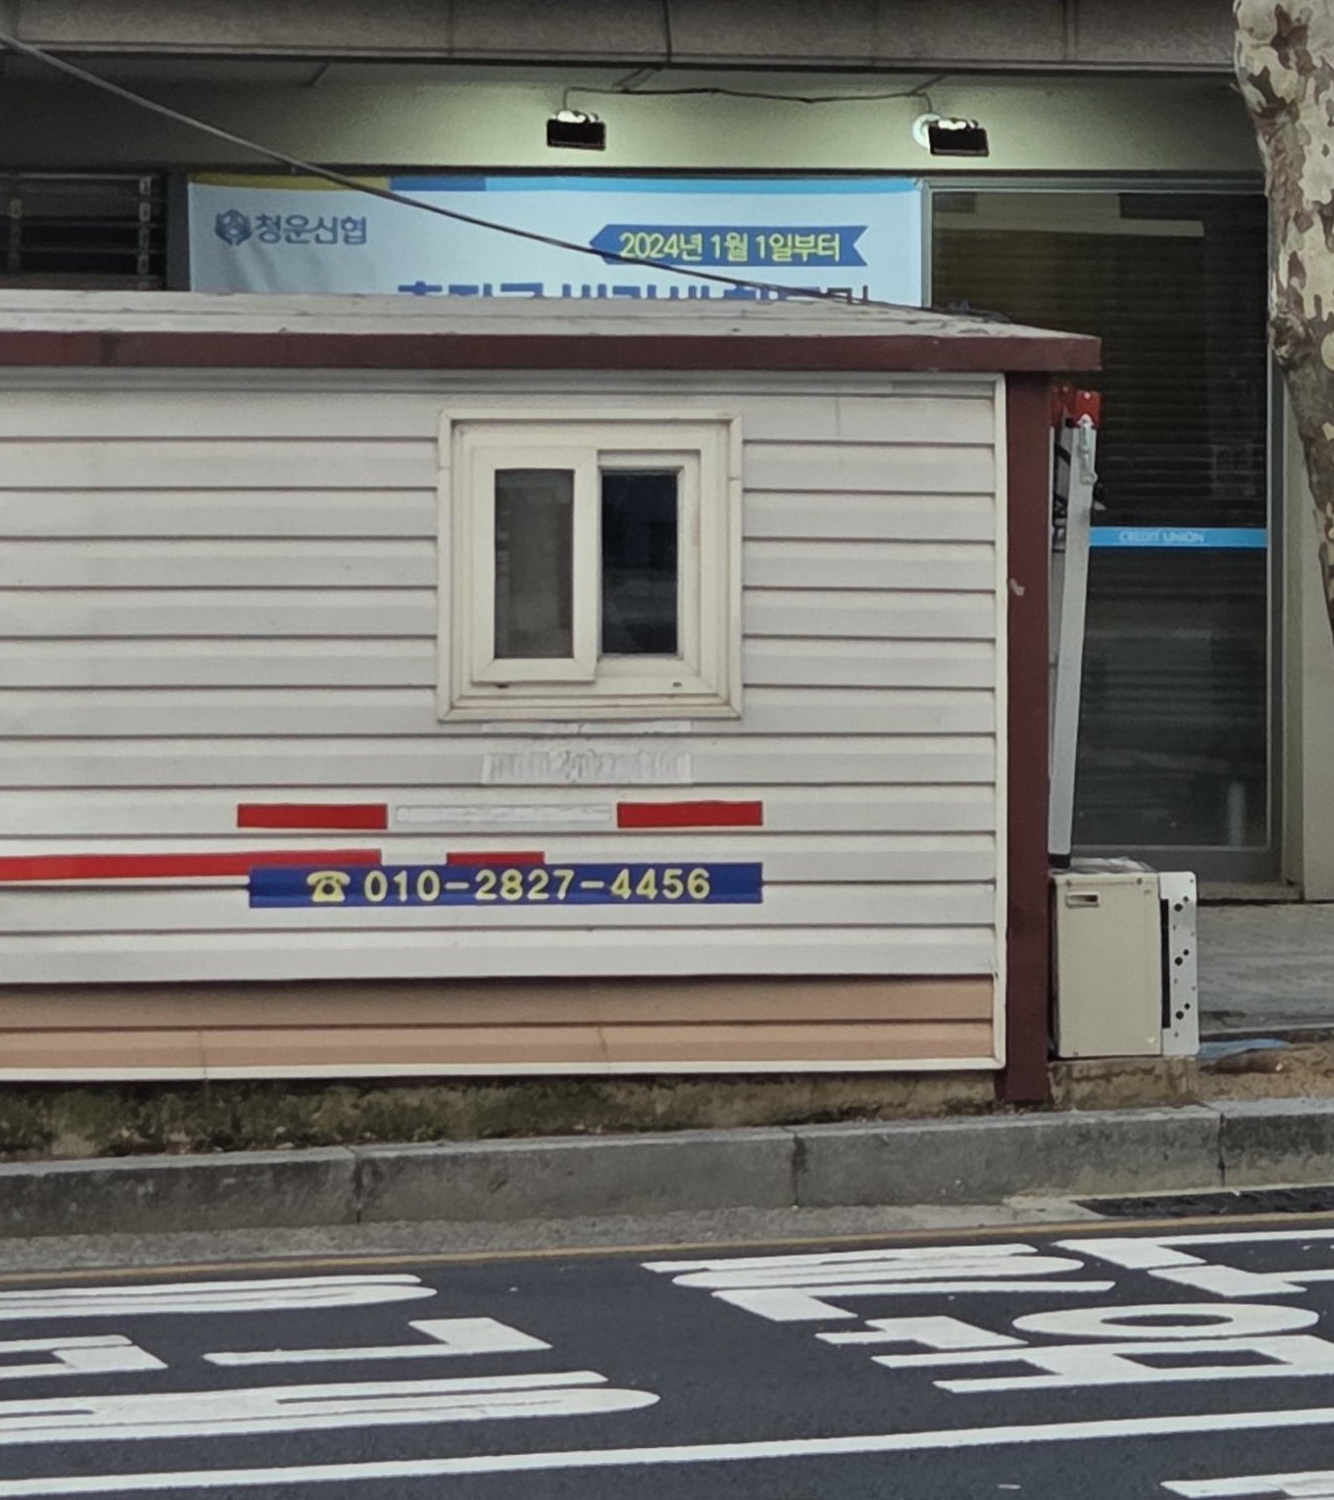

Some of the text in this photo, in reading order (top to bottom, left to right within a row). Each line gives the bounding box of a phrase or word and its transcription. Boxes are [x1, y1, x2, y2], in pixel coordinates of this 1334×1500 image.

[253, 213, 842, 263] 청운신협 2024년 1월 1일부터
[1118, 530, 1206, 544] CREDIT UNION
[363, 866, 711, 903] 010-2827-4456
